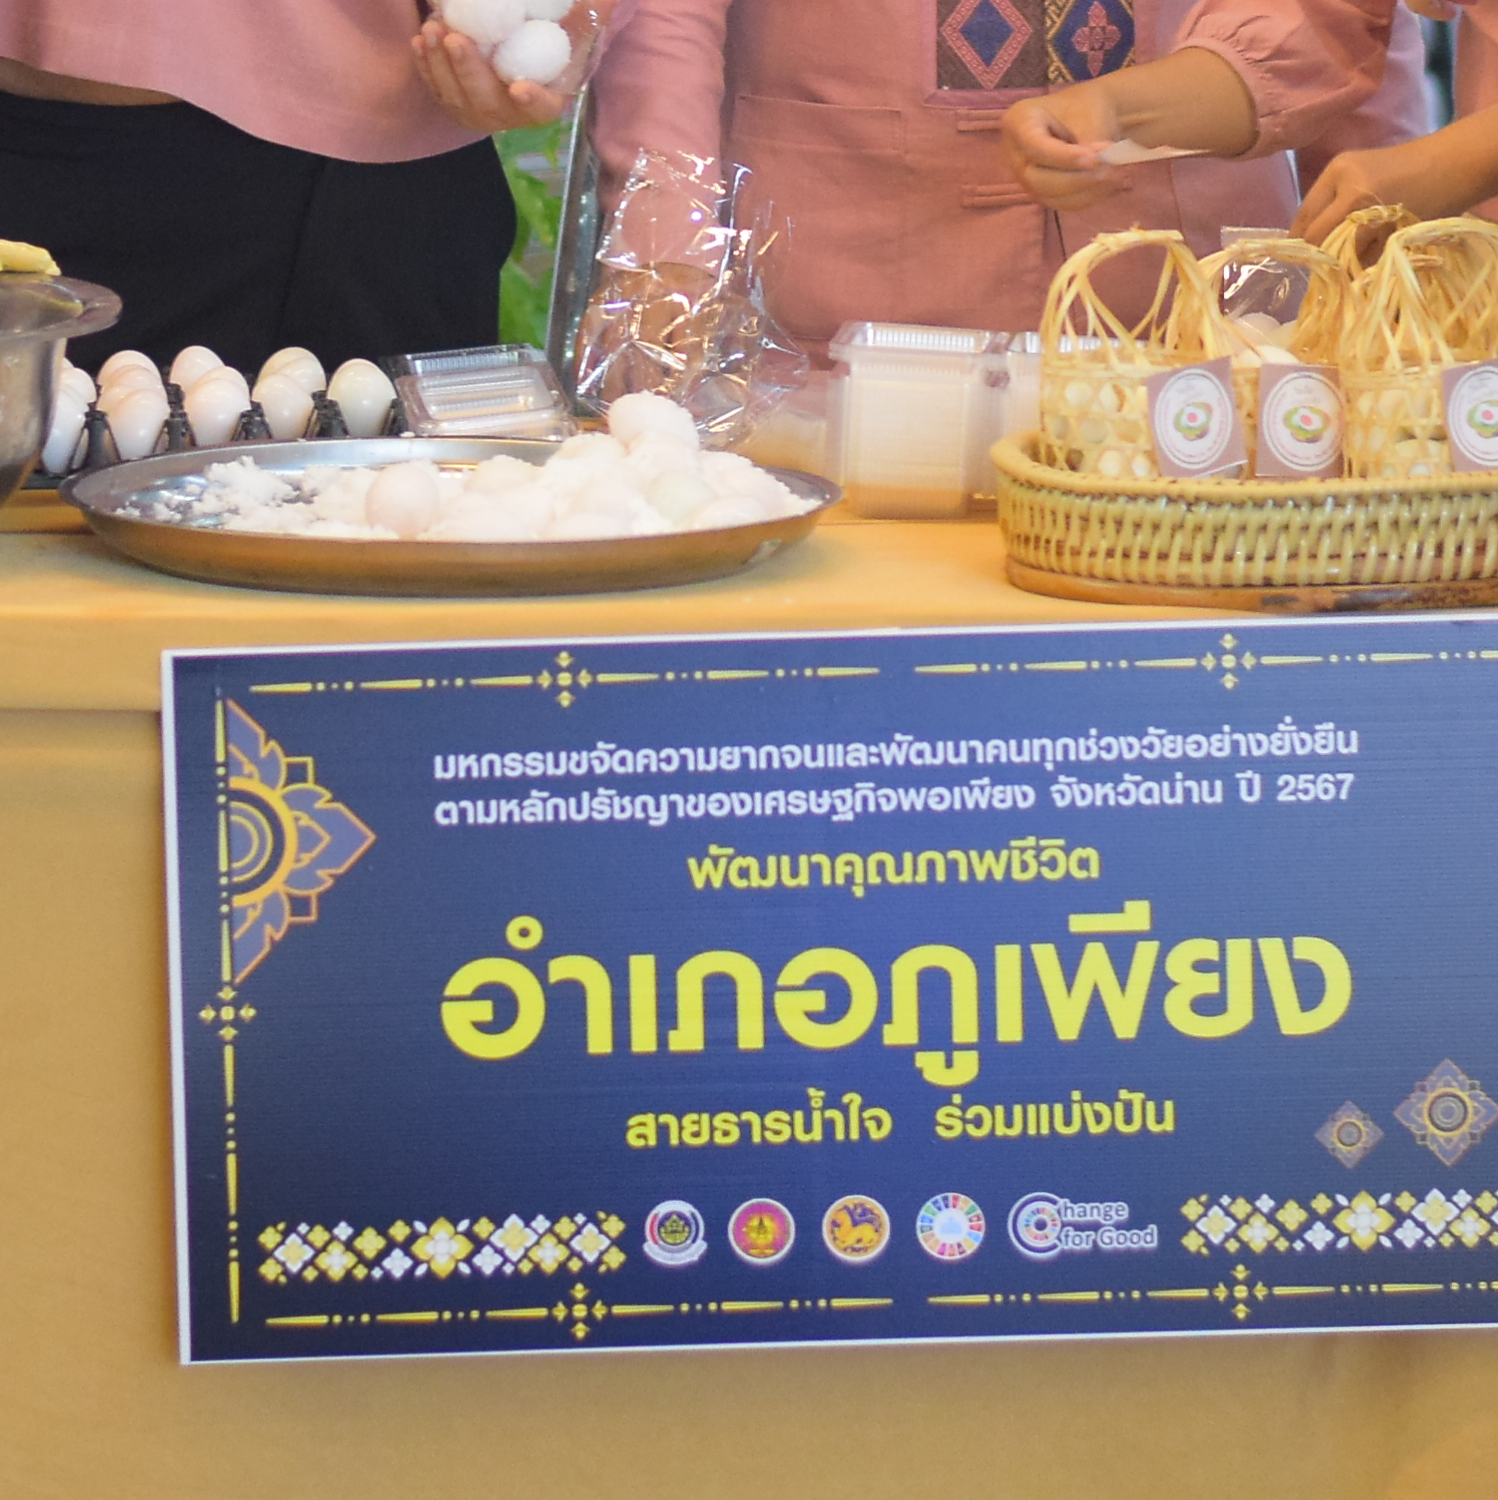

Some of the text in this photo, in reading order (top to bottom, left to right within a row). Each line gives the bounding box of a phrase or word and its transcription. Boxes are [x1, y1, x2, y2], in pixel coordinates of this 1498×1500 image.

[433, 714, 1359, 780] มหกรรมขจัดความยากจนและพัฒนาคนทุกช่วงวัยอย่างยั่งยืน
[434, 769, 1356, 826] ตามหลักปรัชญาของเศรษฐกิจพอเพียง จังหวัดน่าน ปี 2567
[687, 835, 1100, 897] พัฒนาคุณภาพชีวิต
[440, 900, 1354, 1087] อำเภอภูเพียง
[625, 1087, 1176, 1147] สายธารน้ำใจ ร่วมแบ่งปัน
[1062, 1225, 1158, 1249] for Good
